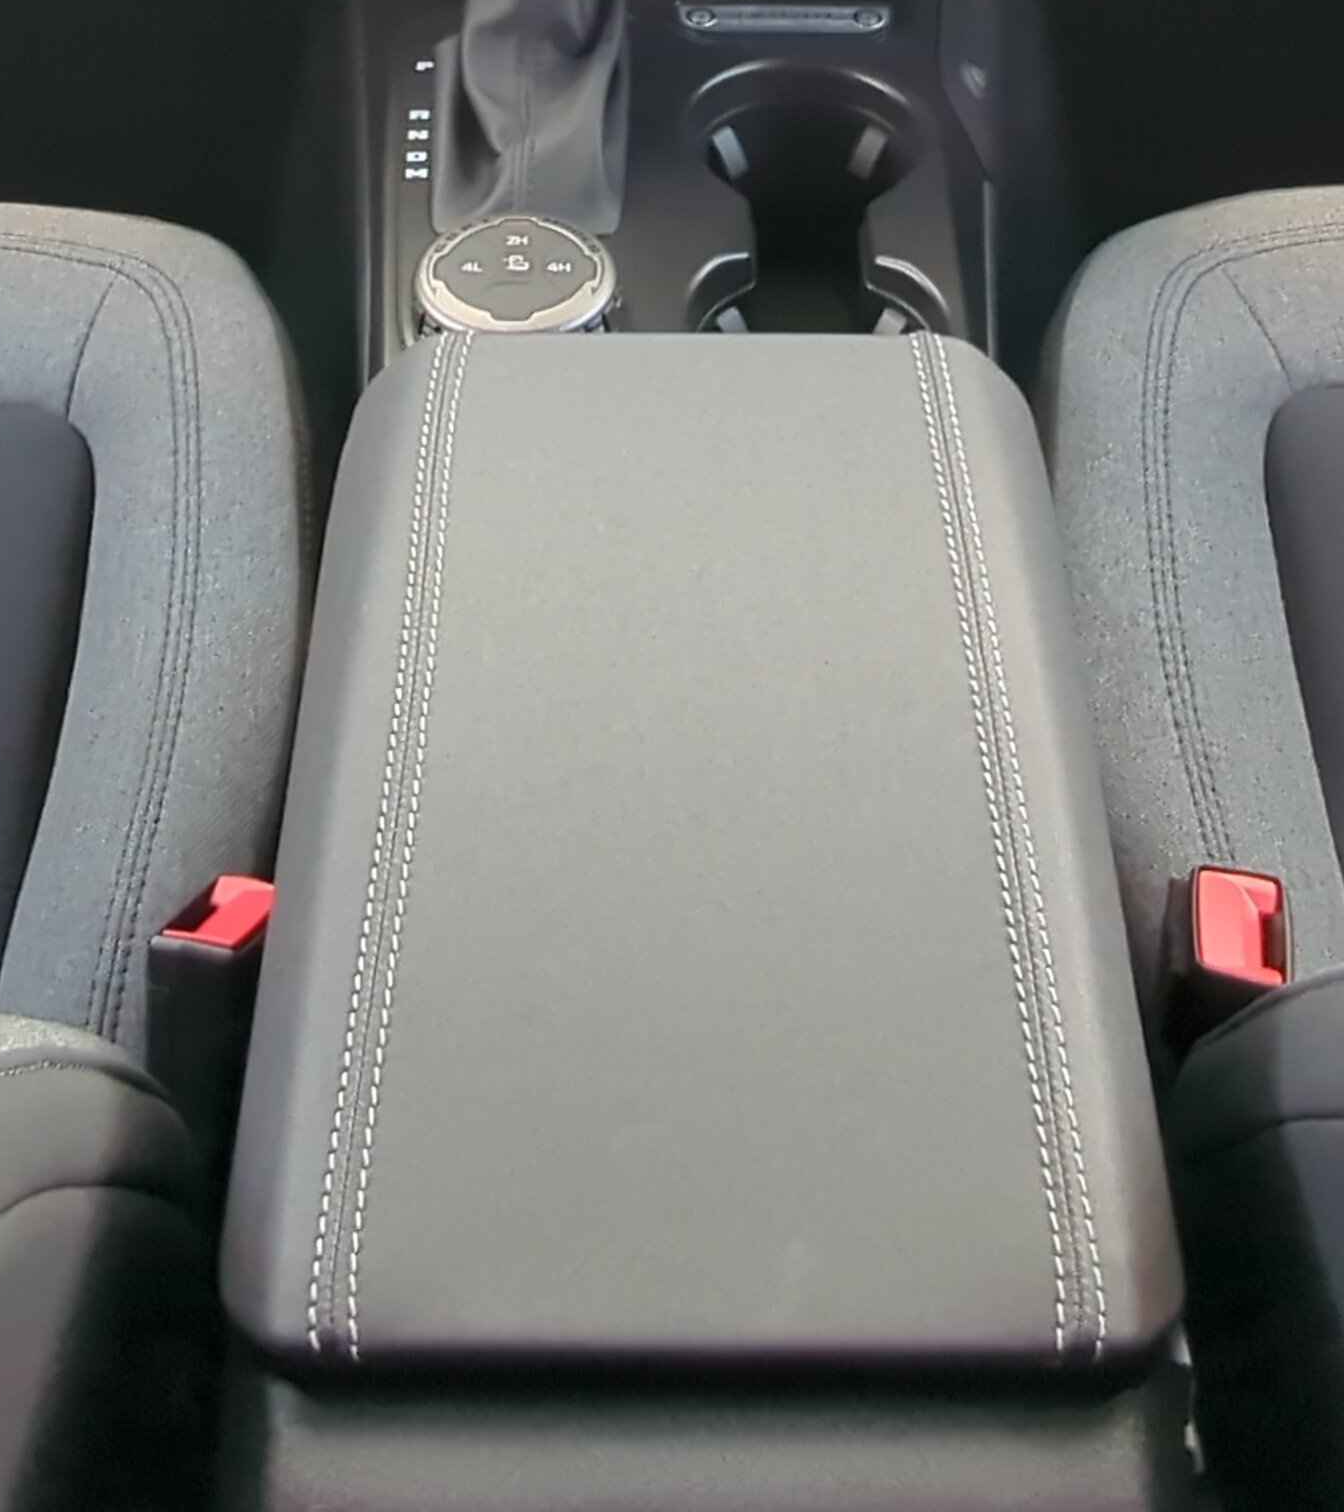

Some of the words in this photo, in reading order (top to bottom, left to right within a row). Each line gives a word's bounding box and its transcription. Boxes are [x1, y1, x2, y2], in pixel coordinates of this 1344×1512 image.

[405, 150, 428, 162] D
[505, 235, 529, 246] 2H
[461, 261, 484, 272] 4L
[546, 261, 572, 272] 4H
